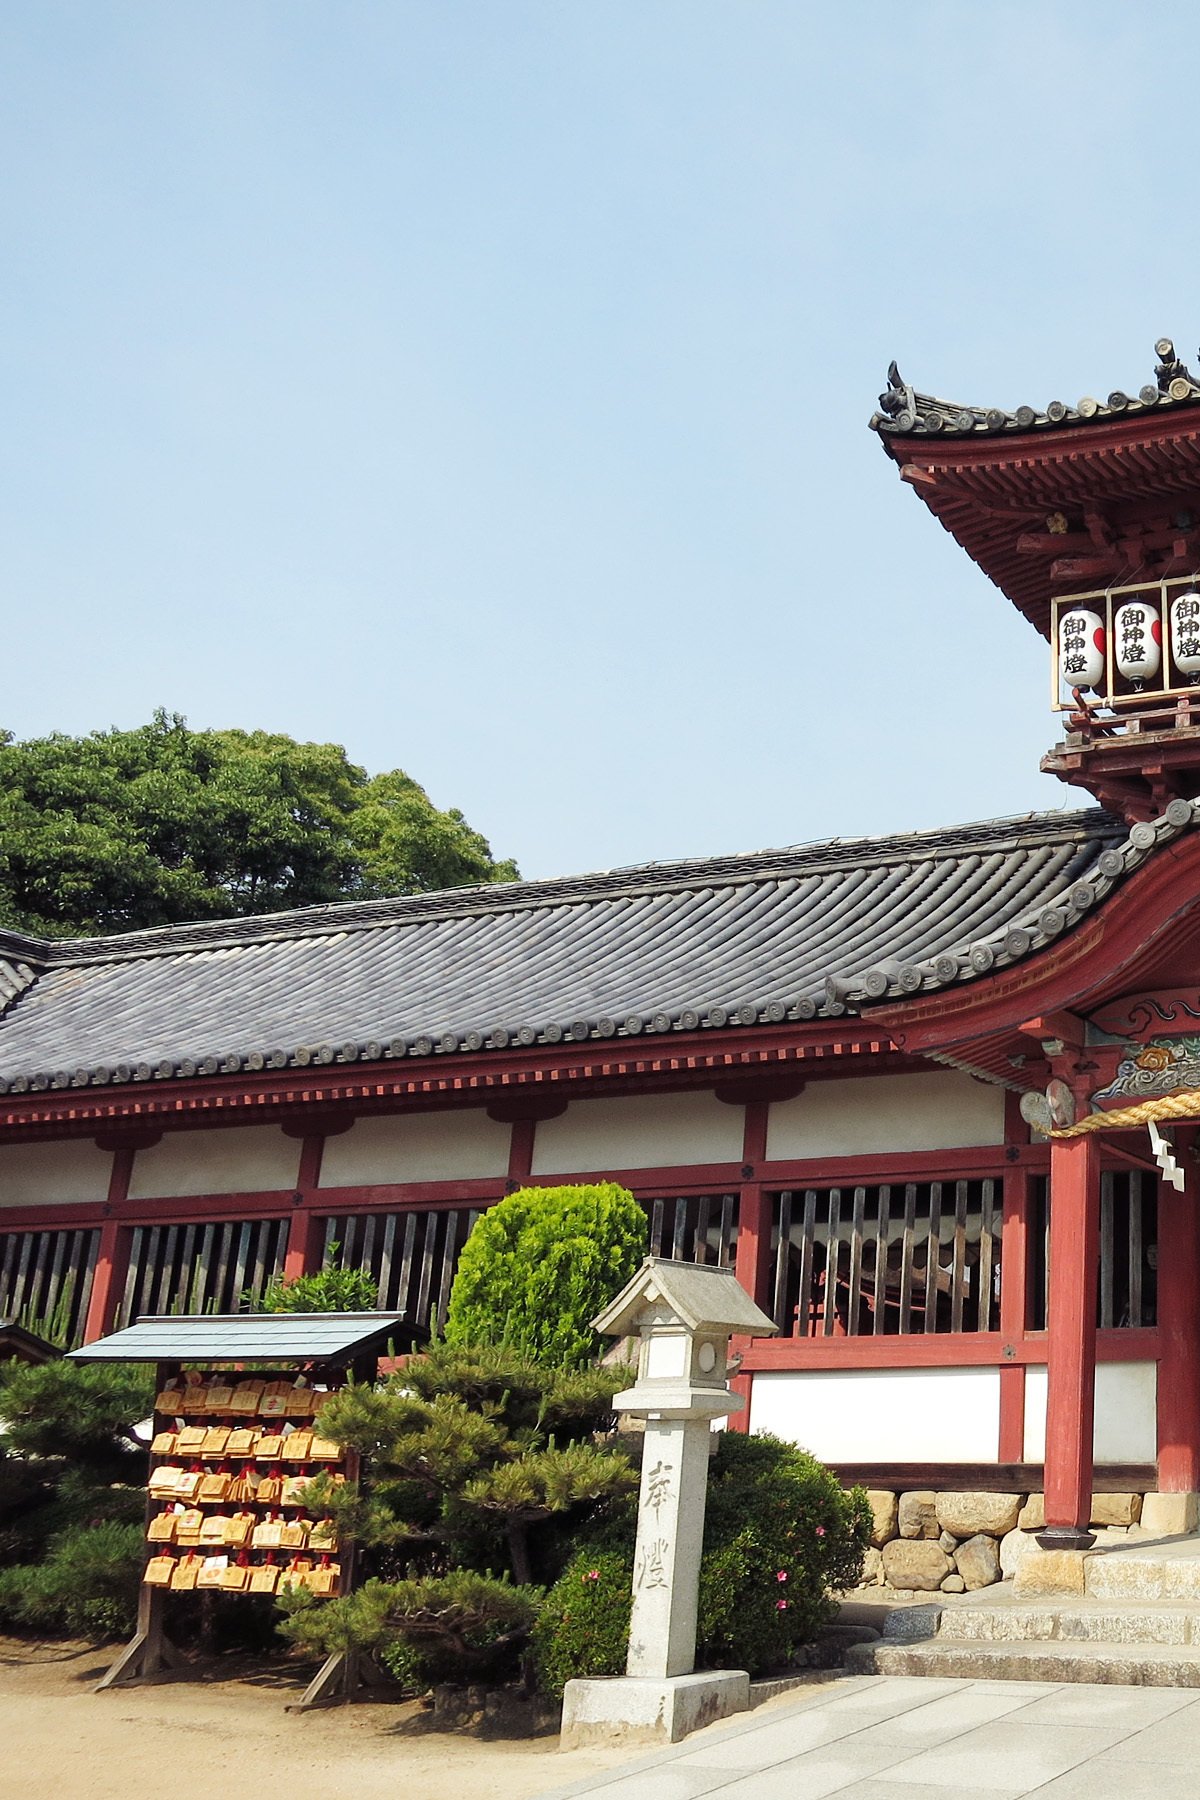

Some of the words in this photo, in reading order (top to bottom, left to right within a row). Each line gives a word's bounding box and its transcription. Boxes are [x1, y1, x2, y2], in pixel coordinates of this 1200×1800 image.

[1063, 616, 1088, 674] 御神燈
[1121, 607, 1147, 663] 御神燈
